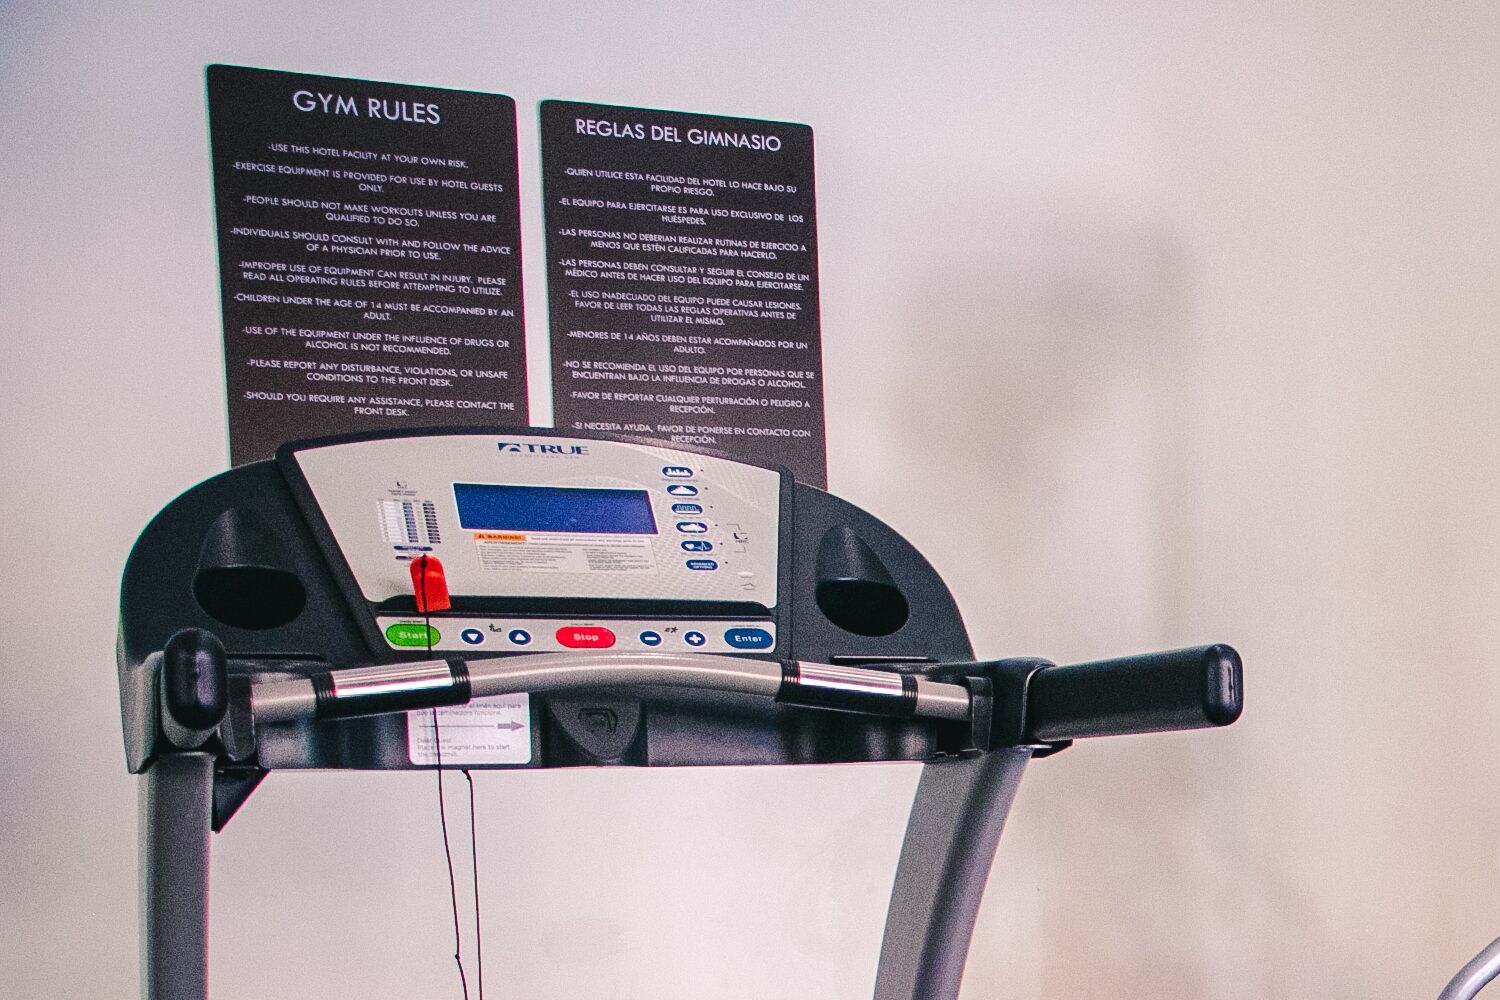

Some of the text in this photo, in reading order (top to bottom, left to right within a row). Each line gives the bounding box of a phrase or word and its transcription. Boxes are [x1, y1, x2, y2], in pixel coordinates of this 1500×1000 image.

[292, 89, 440, 124] GYM RULES
[575, 118, 781, 151] REGLAS DEL GIMNASIO
[291, 145, 309, 153] THIS
[312, 147, 339, 156] HOTEL
[342, 150, 377, 159] FACILITY
[393, 154, 418, 163] YOUR
[420, 156, 445, 166] OWN
[447, 159, 468, 168] RISK.
[278, 165, 329, 176] EQUIPMENT
[343, 171, 386, 182] PROVIDED
[389, 175, 406, 183] FOR
[409, 177, 425, 185] USE
[441, 179, 468, 188] HOTEL
[470, 182, 502, 191] GUESTS
[594, 170, 622, 178] UTILICE
[645, 174, 685, 183] FACILIDAD
[702, 178, 726, 187] HOTEL
[741, 181, 762, 190] HACE
[764, 183, 784, 191] BAJO
[358, 183, 384, 192] ONLY.
[650, 184, 714, 196] PROPIO RIESGO.
[281, 198, 318, 208] SHOULD
[320, 201, 340, 209] NOT
[343, 203, 367, 212] MAKE
[370, 205, 423, 216] WORKOUTS
[425, 209, 457, 218] UNLESS
[459, 212, 478, 220] YOU
[325, 212, 419, 226] QUALIFIED TO DO SO.
[661, 214, 706, 224] HUÉSPEDES.
[292, 231, 329, 241] SHOULD
[331, 234, 372, 244] CONSULT
[422, 240, 460, 250] FOLLOW
[480, 245, 510, 254] ADVICE
[590, 240, 620, 248] MENOS
[642, 242, 665, 251] ESTÉN
[667, 245, 717, 255] CALIFICADAS
[740, 250, 776, 259] HACERLO.
[331, 245, 377, 255] PHYSICIAN
[380, 248, 405, 257] PRIOR
[422, 251, 440, 259] USE.
[243, 271, 266, 280] READ
[286, 275, 337, 284] OPERATING
[340, 278, 365, 286] RULES
[368, 280, 399, 288] BEFORE
[402, 282, 455, 292] ATTEMPTING
[472, 286, 502, 295] UTILIZE.
[324, 266, 374, 276] EQUIPMENT
[399, 271, 427, 280] RESULT
[442, 274, 472, 282] INJURY.
[477, 276, 506, 285] PLEASE
[564, 267, 597, 277] MÉDICO
[600, 271, 625, 279] ANTES
[702, 277, 733, 286] EQUIPO
[635, 303, 662, 311] TODAS
[680, 306, 710, 314] REGLAS
[712, 308, 758, 317] OPERATIVAS
[650, 314, 683, 322] UTILIZAR
[694, 316, 724, 325] MISMO.
[305, 340, 348, 349] ALCOHOL
[382, 344, 451, 354] RECOMMENDED.
[283, 360, 316, 369] REPORT
[341, 363, 401, 374] DISTURBANCE,
[404, 366, 457, 376] VIOLATIONS,
[475, 370, 507, 378] UNSAFE
[306, 372, 363, 382] CONDITIONS
[398, 376, 427, 385] FRONT
[429, 378, 452, 386] DESK.
[353, 406, 383, 414] FRONT
[522, 444, 590, 455] TRUE
[573, 634, 599, 642] Stop
